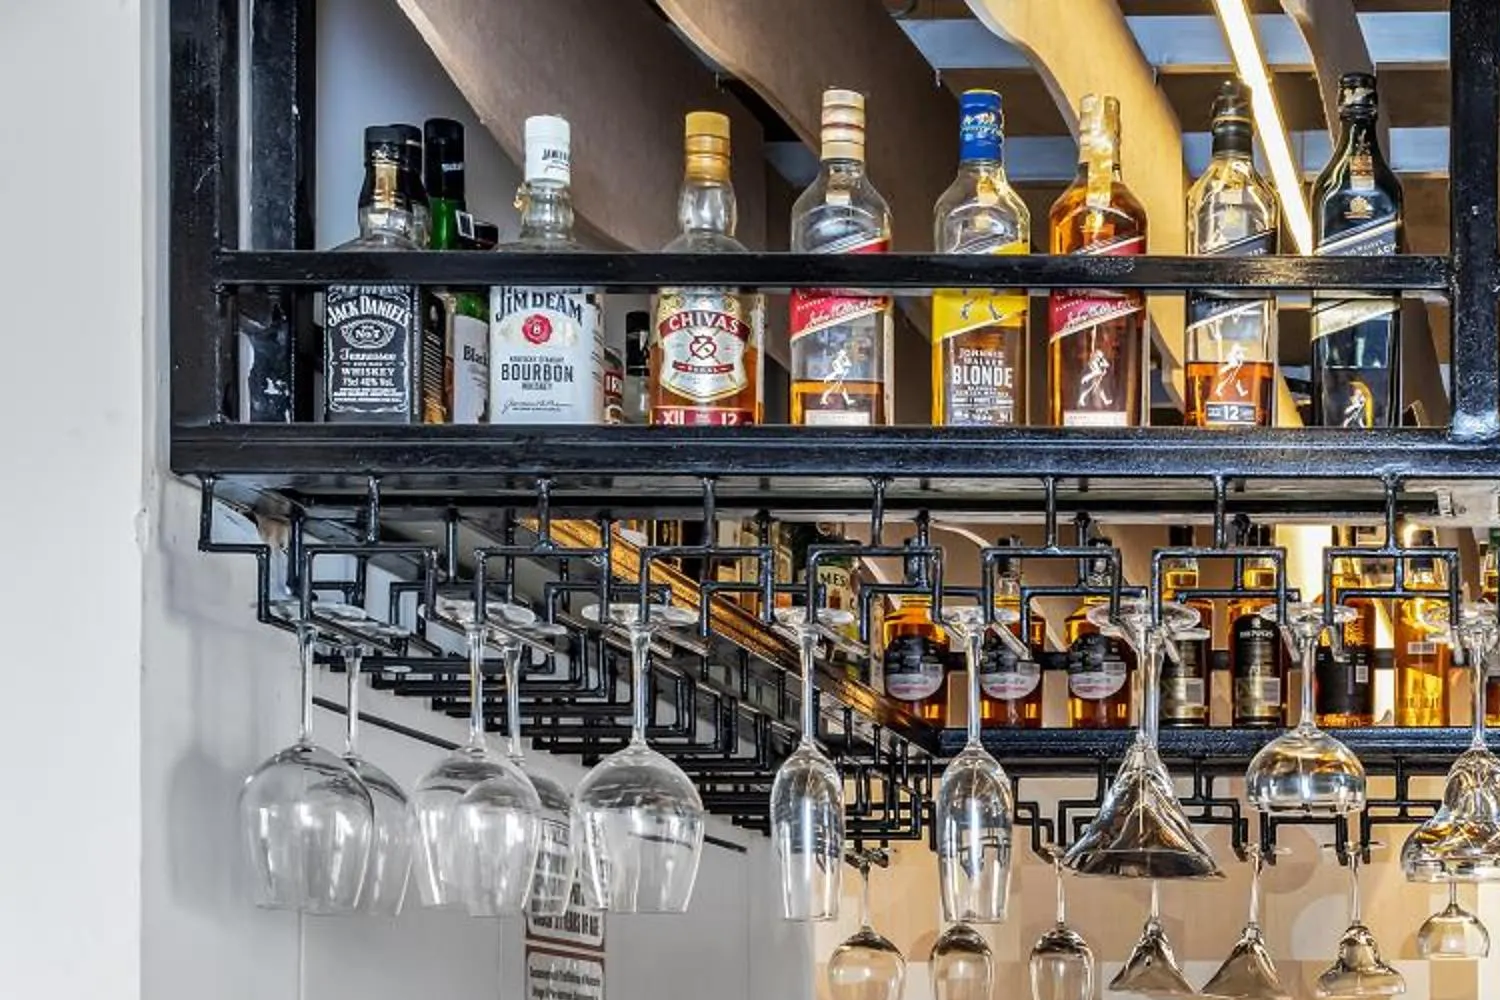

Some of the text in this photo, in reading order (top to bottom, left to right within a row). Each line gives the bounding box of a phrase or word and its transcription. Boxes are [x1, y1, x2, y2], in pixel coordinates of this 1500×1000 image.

[328, 299, 359, 327] JACK
[669, 311, 739, 333] CHIVAS
[341, 367, 395, 377] WHISKEY
[501, 363, 574, 383] BOURBON
[952, 365, 1013, 388] BLONDE
[721, 412, 738, 425] 12
[1223, 405, 1239, 420] 12
